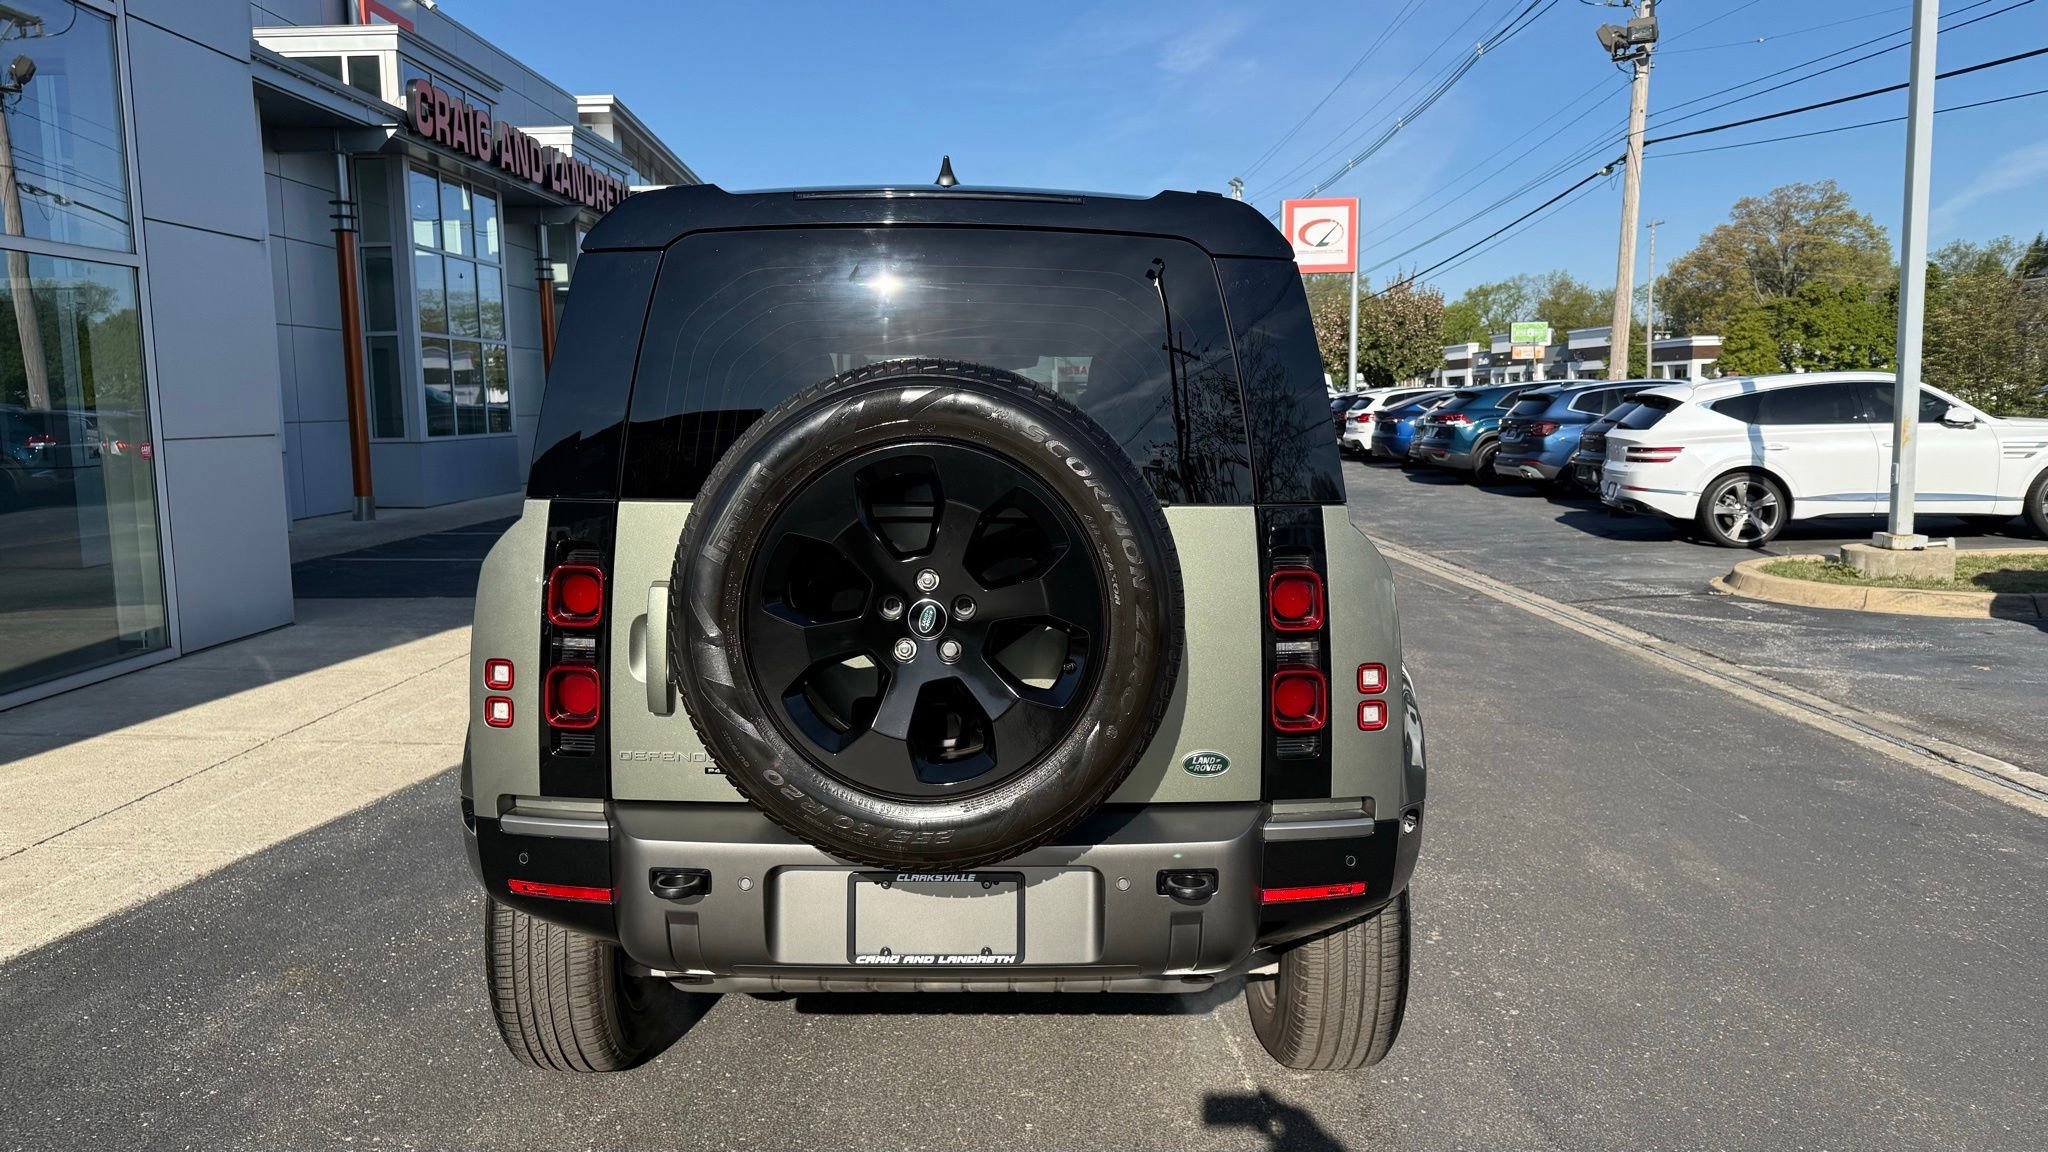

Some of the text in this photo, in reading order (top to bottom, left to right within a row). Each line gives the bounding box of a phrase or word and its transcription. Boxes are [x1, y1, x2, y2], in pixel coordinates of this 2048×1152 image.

[407, 78, 493, 162] CRAIG
[500, 121, 544, 185] AND
[1019, 424, 1152, 715] SCORPION ZERO
[619, 751, 716, 763] DEFEND
[1192, 756, 1216, 765] LAND
[1193, 764, 1223, 772] ROVER
[896, 873, 977, 882] CLARKSVILLE
[855, 955, 1017, 964] CRAIG AND LANDRETH
